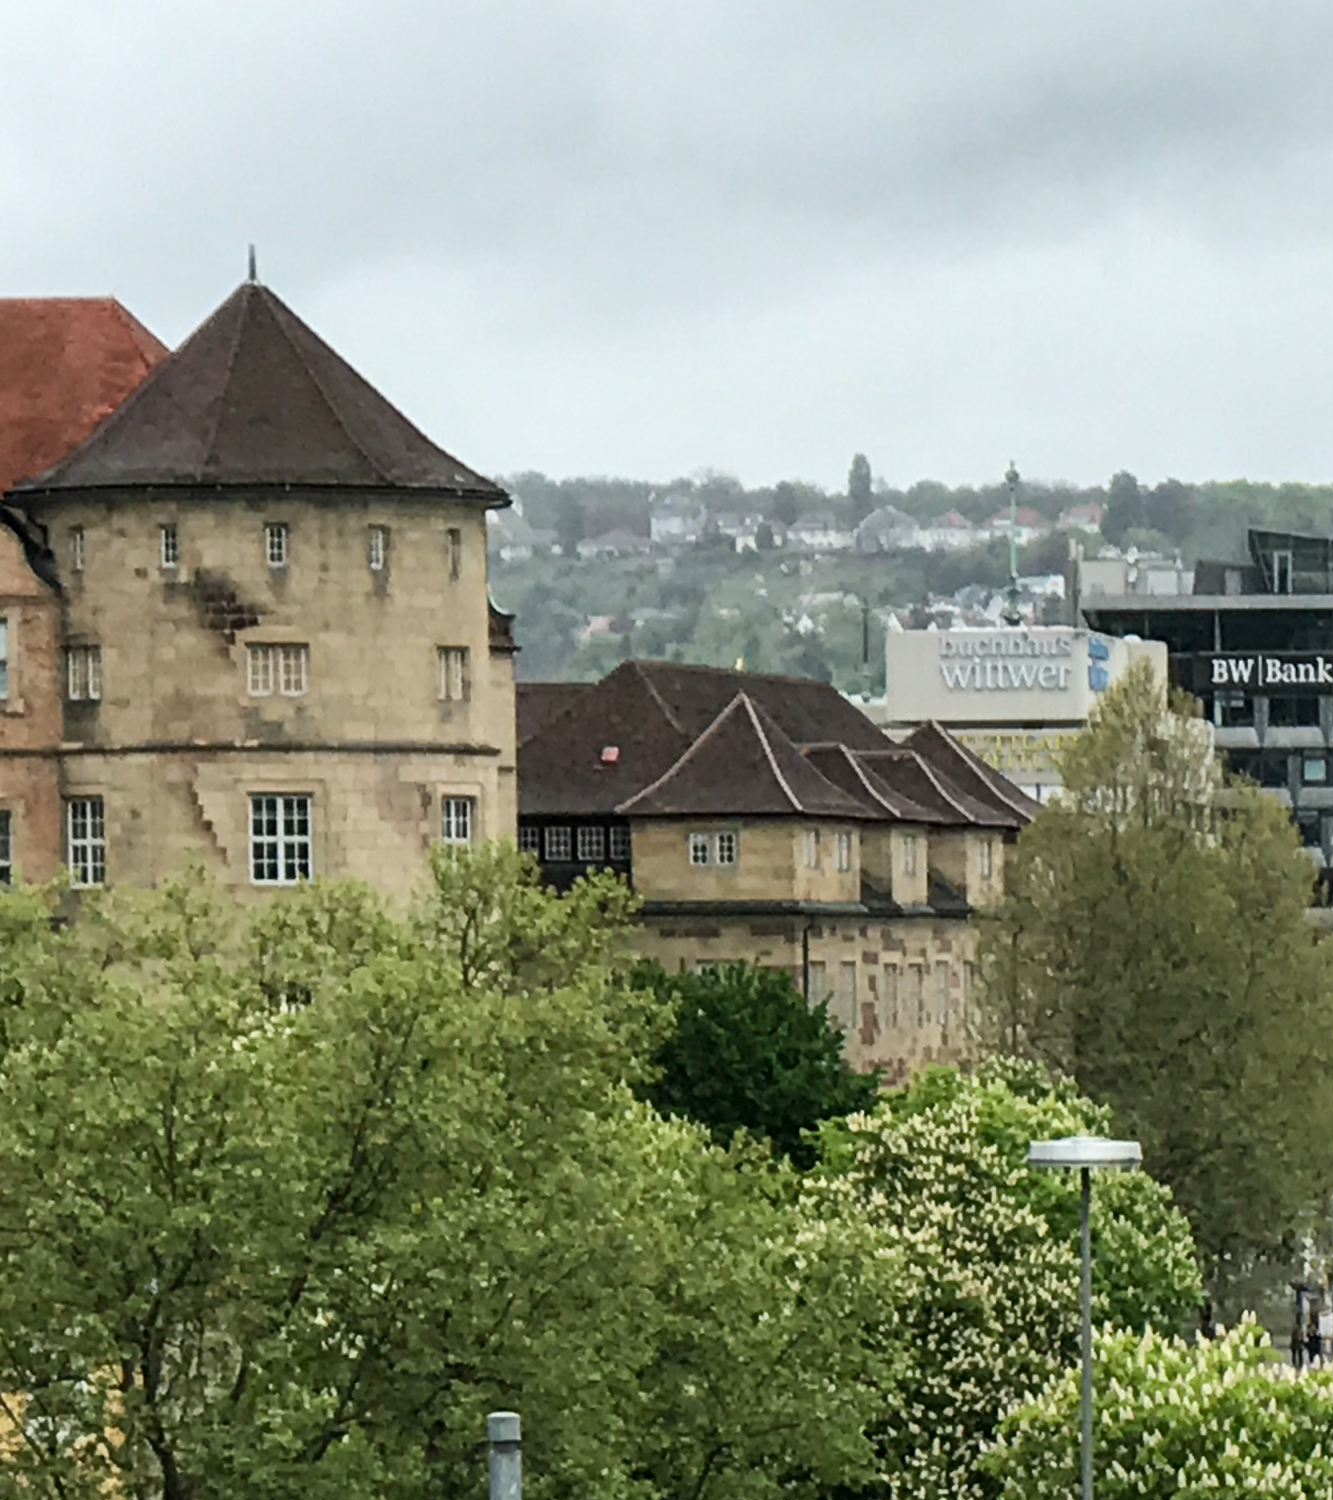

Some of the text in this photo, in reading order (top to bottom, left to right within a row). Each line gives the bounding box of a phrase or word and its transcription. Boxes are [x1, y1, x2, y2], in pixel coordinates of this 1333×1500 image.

[939, 635, 1071, 659] buchhaus
[940, 659, 1071, 691] wittwer
[1211, 658, 1255, 684] BW
